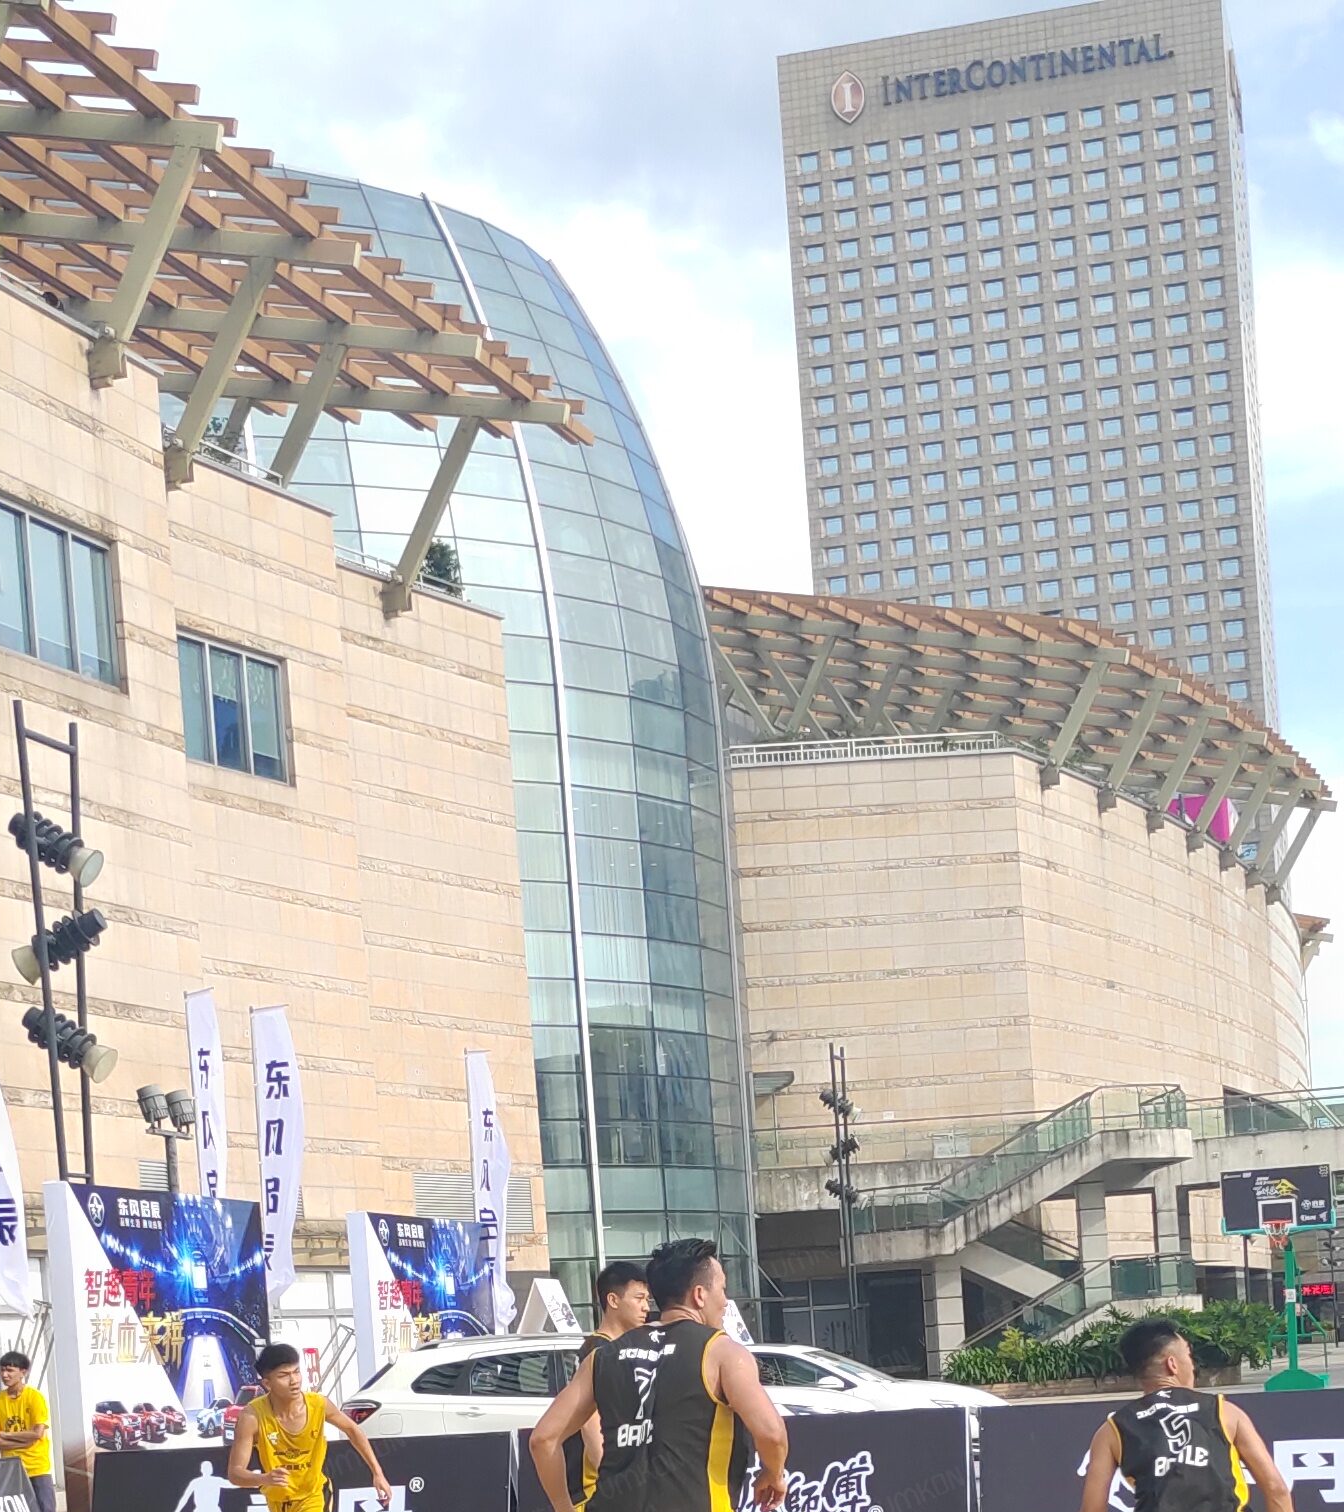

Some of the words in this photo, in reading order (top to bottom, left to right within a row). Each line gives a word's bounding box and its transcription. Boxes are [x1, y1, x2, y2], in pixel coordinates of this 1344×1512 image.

[117, 1197, 161, 1219] 东风启辰
[89, 1310, 186, 1370] 热血来拼
[1159, 1411, 1192, 1455] 5
